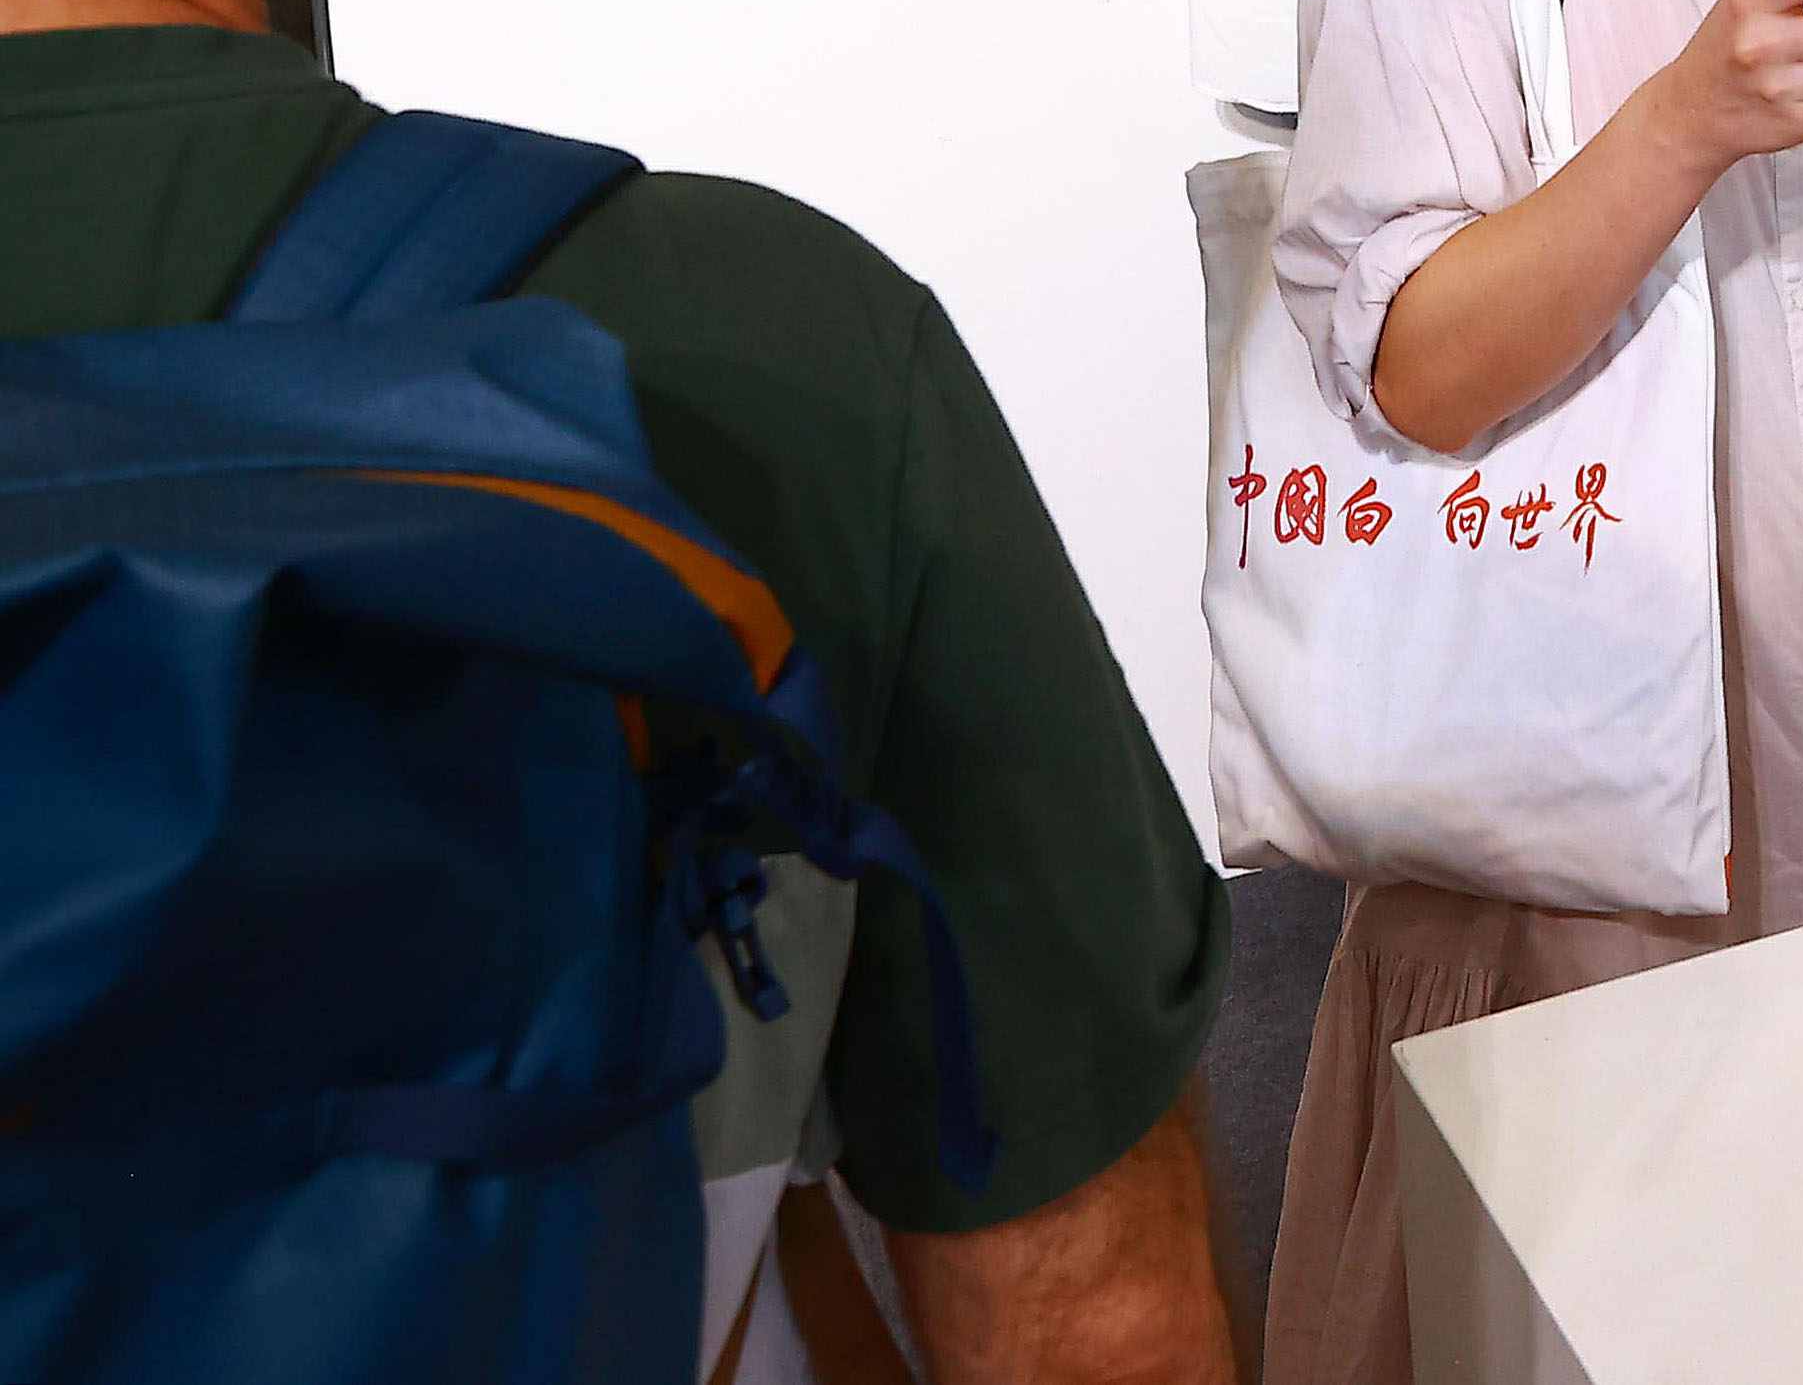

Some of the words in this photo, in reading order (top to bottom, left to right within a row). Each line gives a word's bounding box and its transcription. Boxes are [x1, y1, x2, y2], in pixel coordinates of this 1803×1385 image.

[1228, 443, 1394, 570] 中国白
[1437, 462, 1625, 576] 向世界
